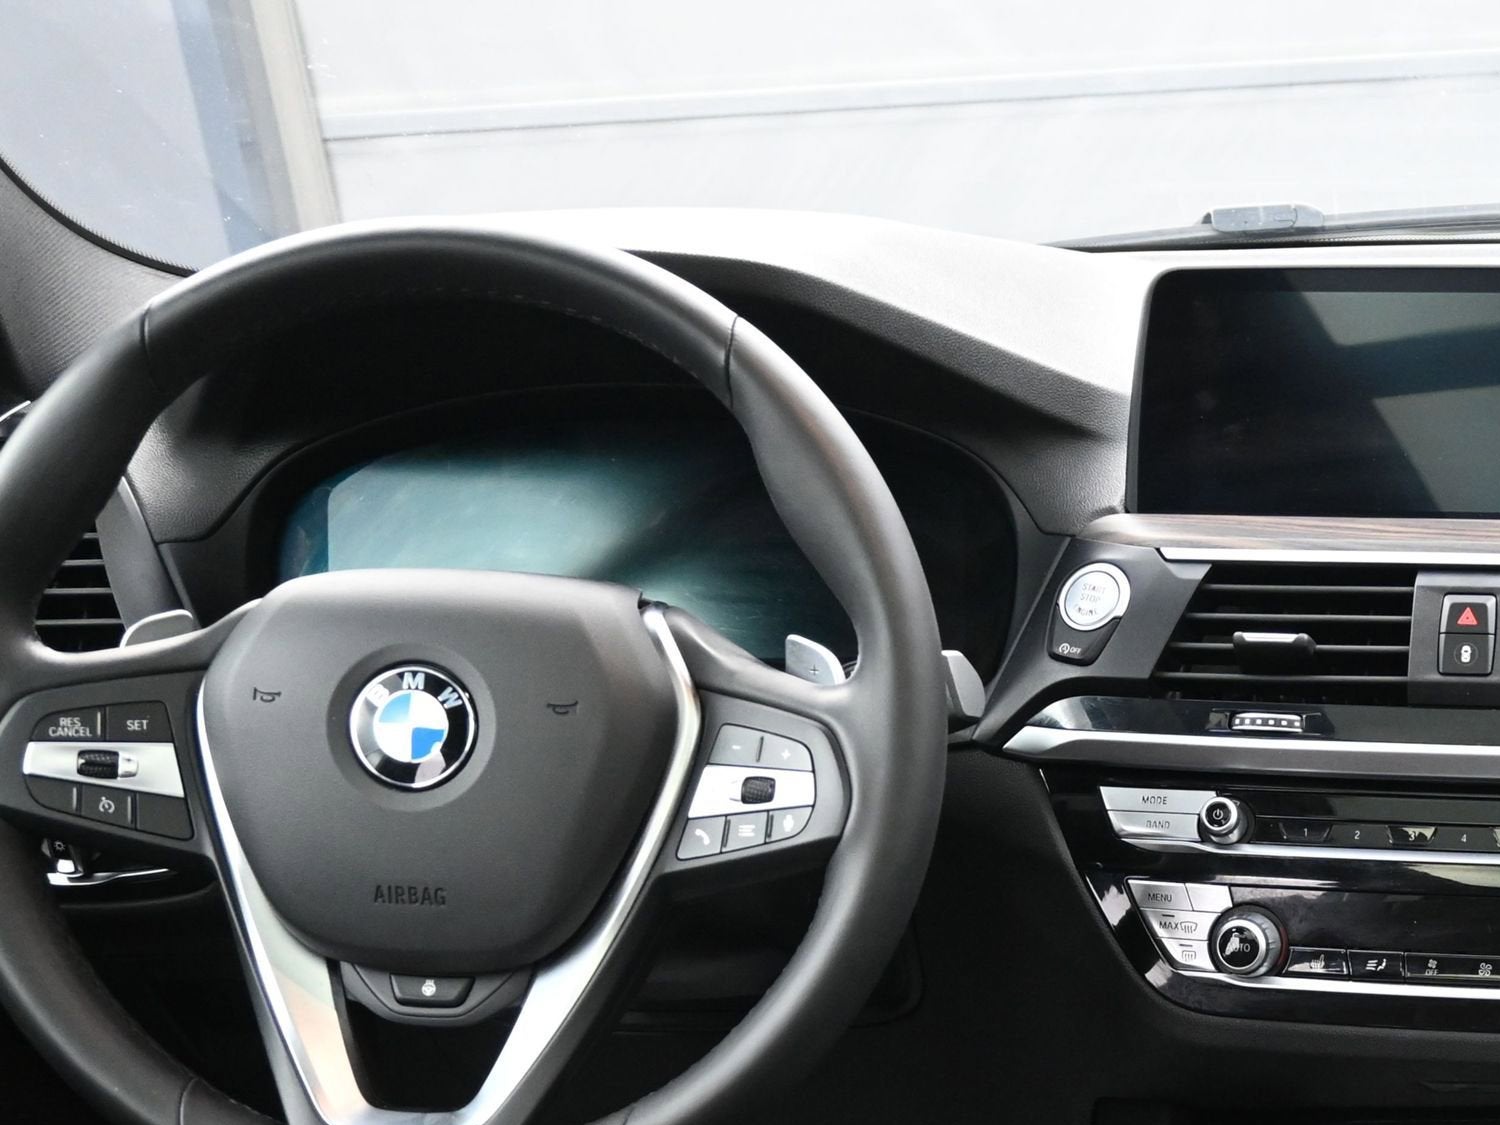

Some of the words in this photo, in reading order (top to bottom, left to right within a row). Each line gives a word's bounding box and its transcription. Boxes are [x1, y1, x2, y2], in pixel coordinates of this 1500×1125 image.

[364, 671, 463, 709] BMW
[59, 717, 82, 727] RES
[126, 719, 149, 731] SET
[48, 726, 93, 737] CANCEL
[1142, 795, 1168, 806] MODE
[373, 885, 447, 907] AIRBAG
[1147, 892, 1173, 903] MENU
[1159, 920, 1180, 931] MAX
